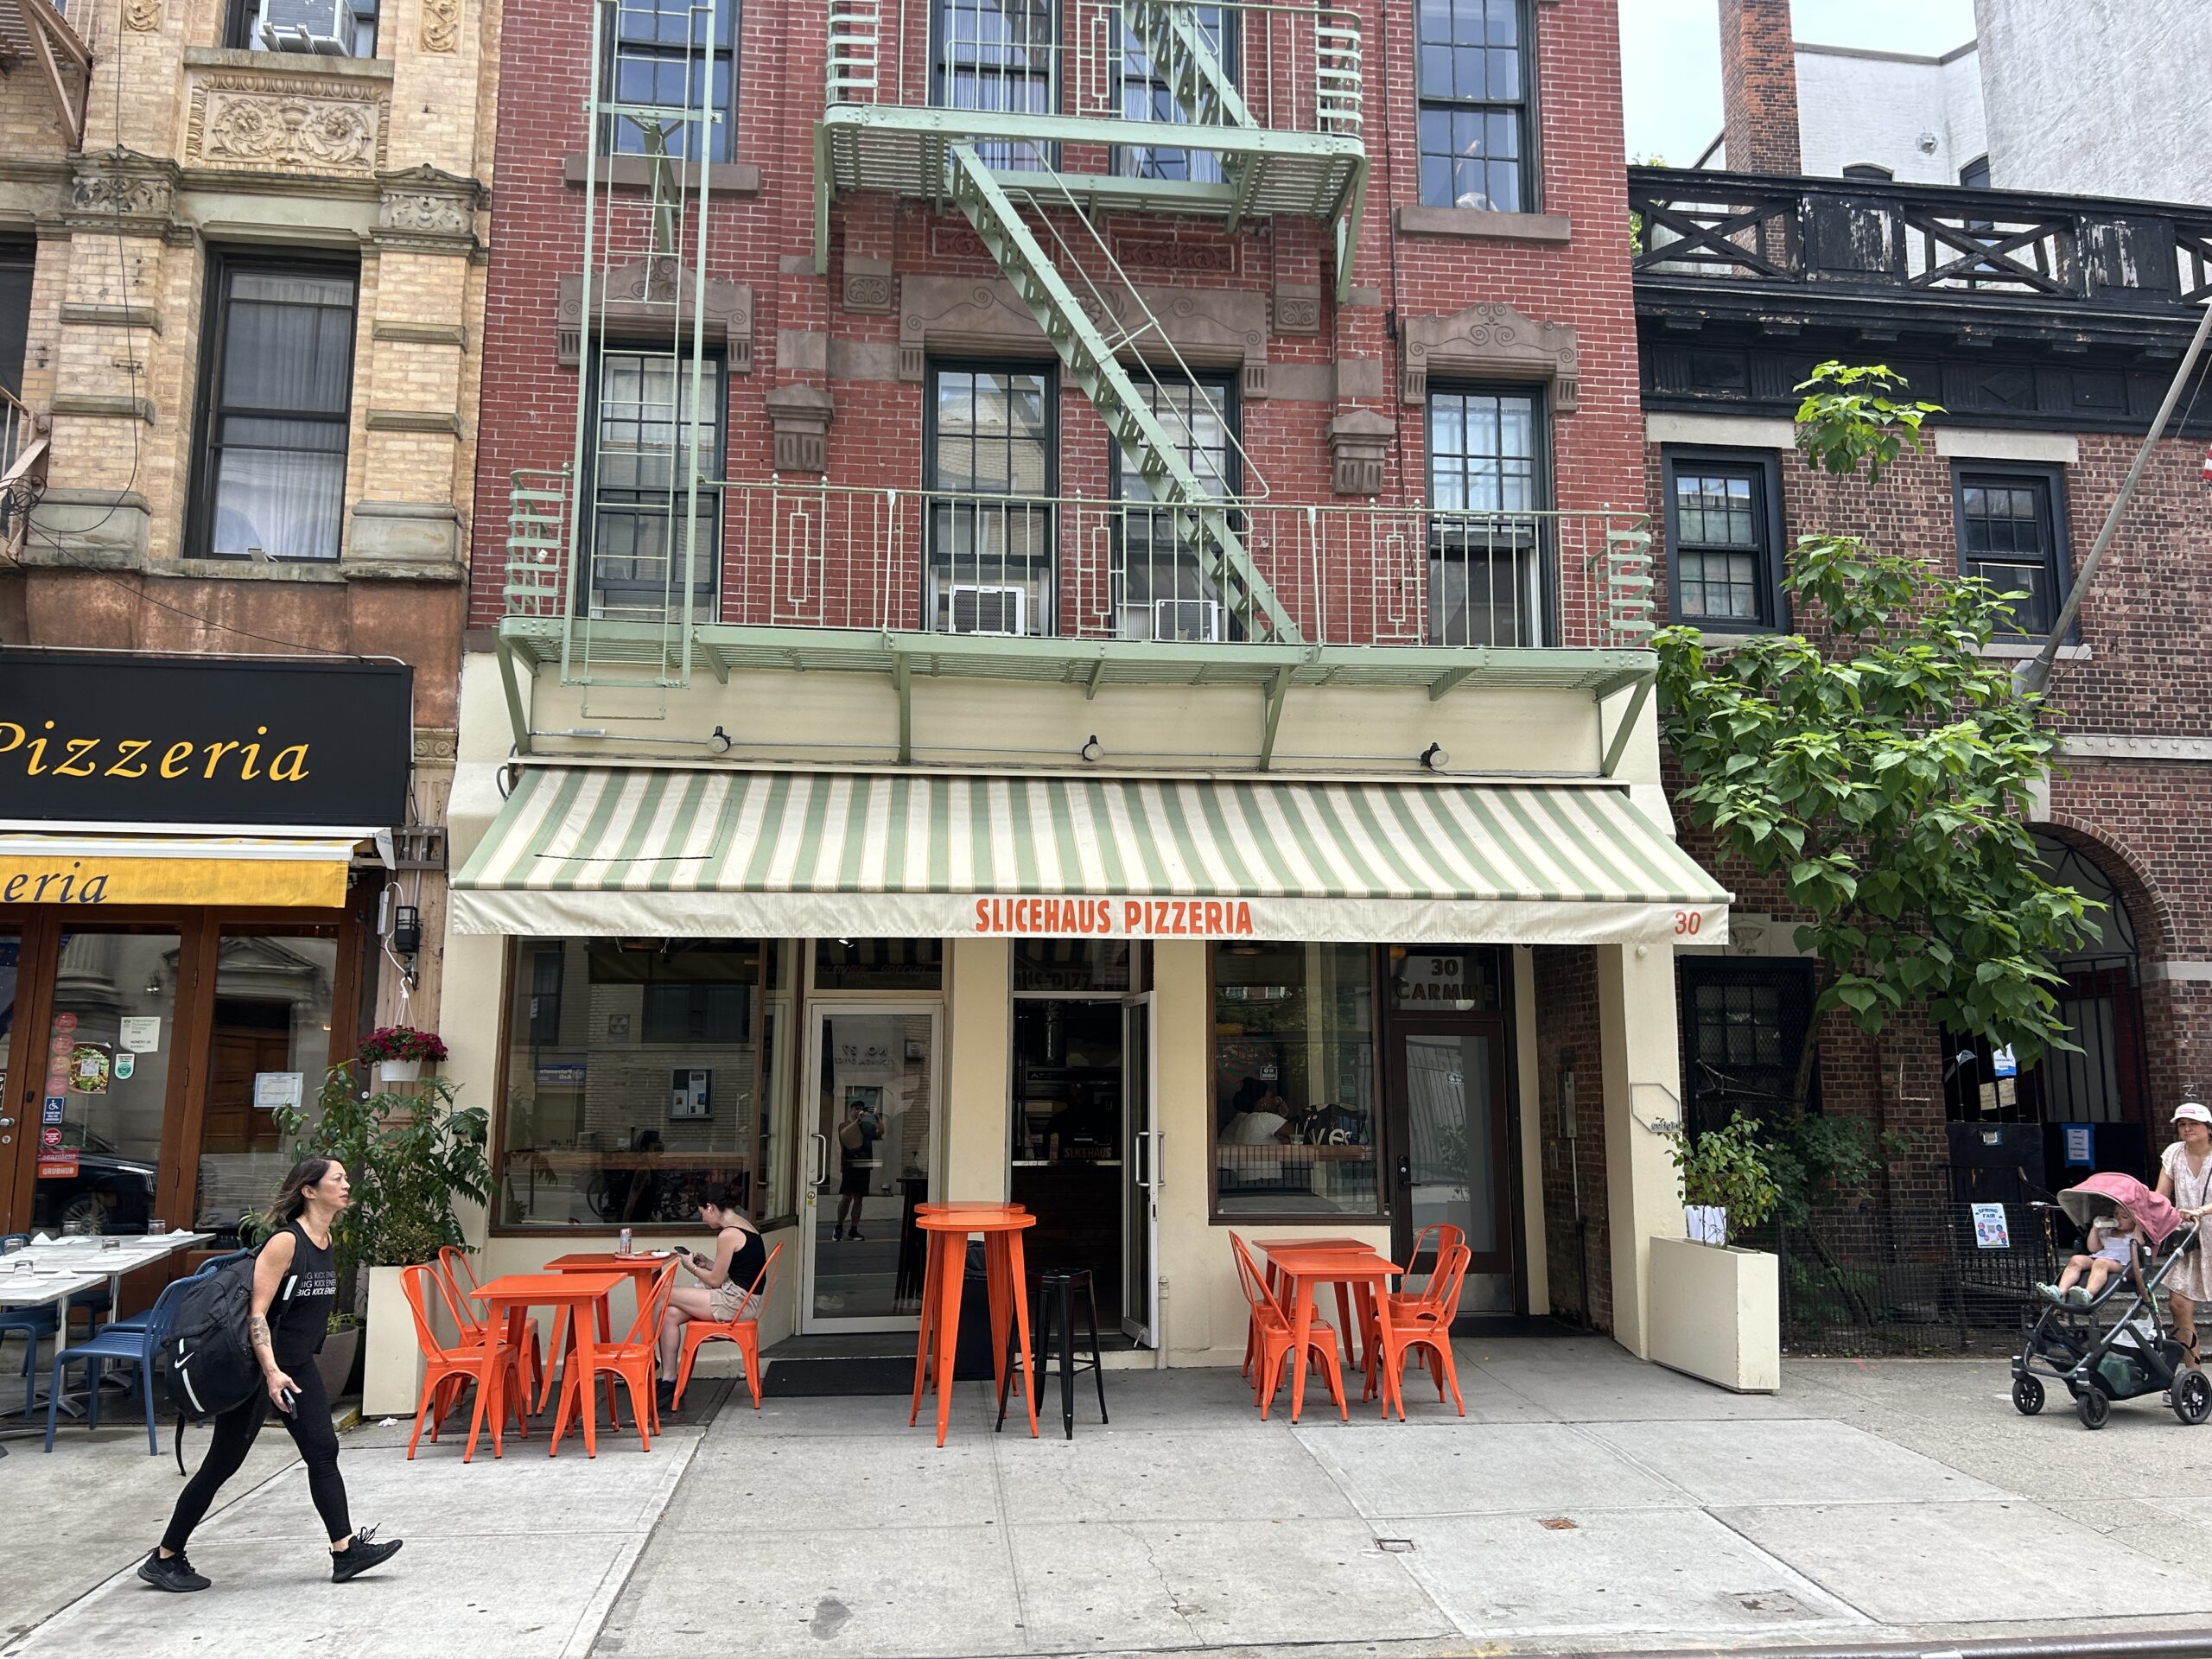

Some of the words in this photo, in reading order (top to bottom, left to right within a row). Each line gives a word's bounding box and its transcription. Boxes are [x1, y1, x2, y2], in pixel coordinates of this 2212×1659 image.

[0, 721, 310, 782] Pizzeria
[3, 861, 109, 904] eria
[976, 899, 1111, 934] SLICEHAUS
[1124, 901, 1254, 935] PIZZERIA
[1675, 912, 1701, 935] 30
[1431, 959, 1459, 976] 30
[1396, 982, 1495, 1001] CARMINE
[1064, 1147, 1113, 1159] SLICEHAUS
